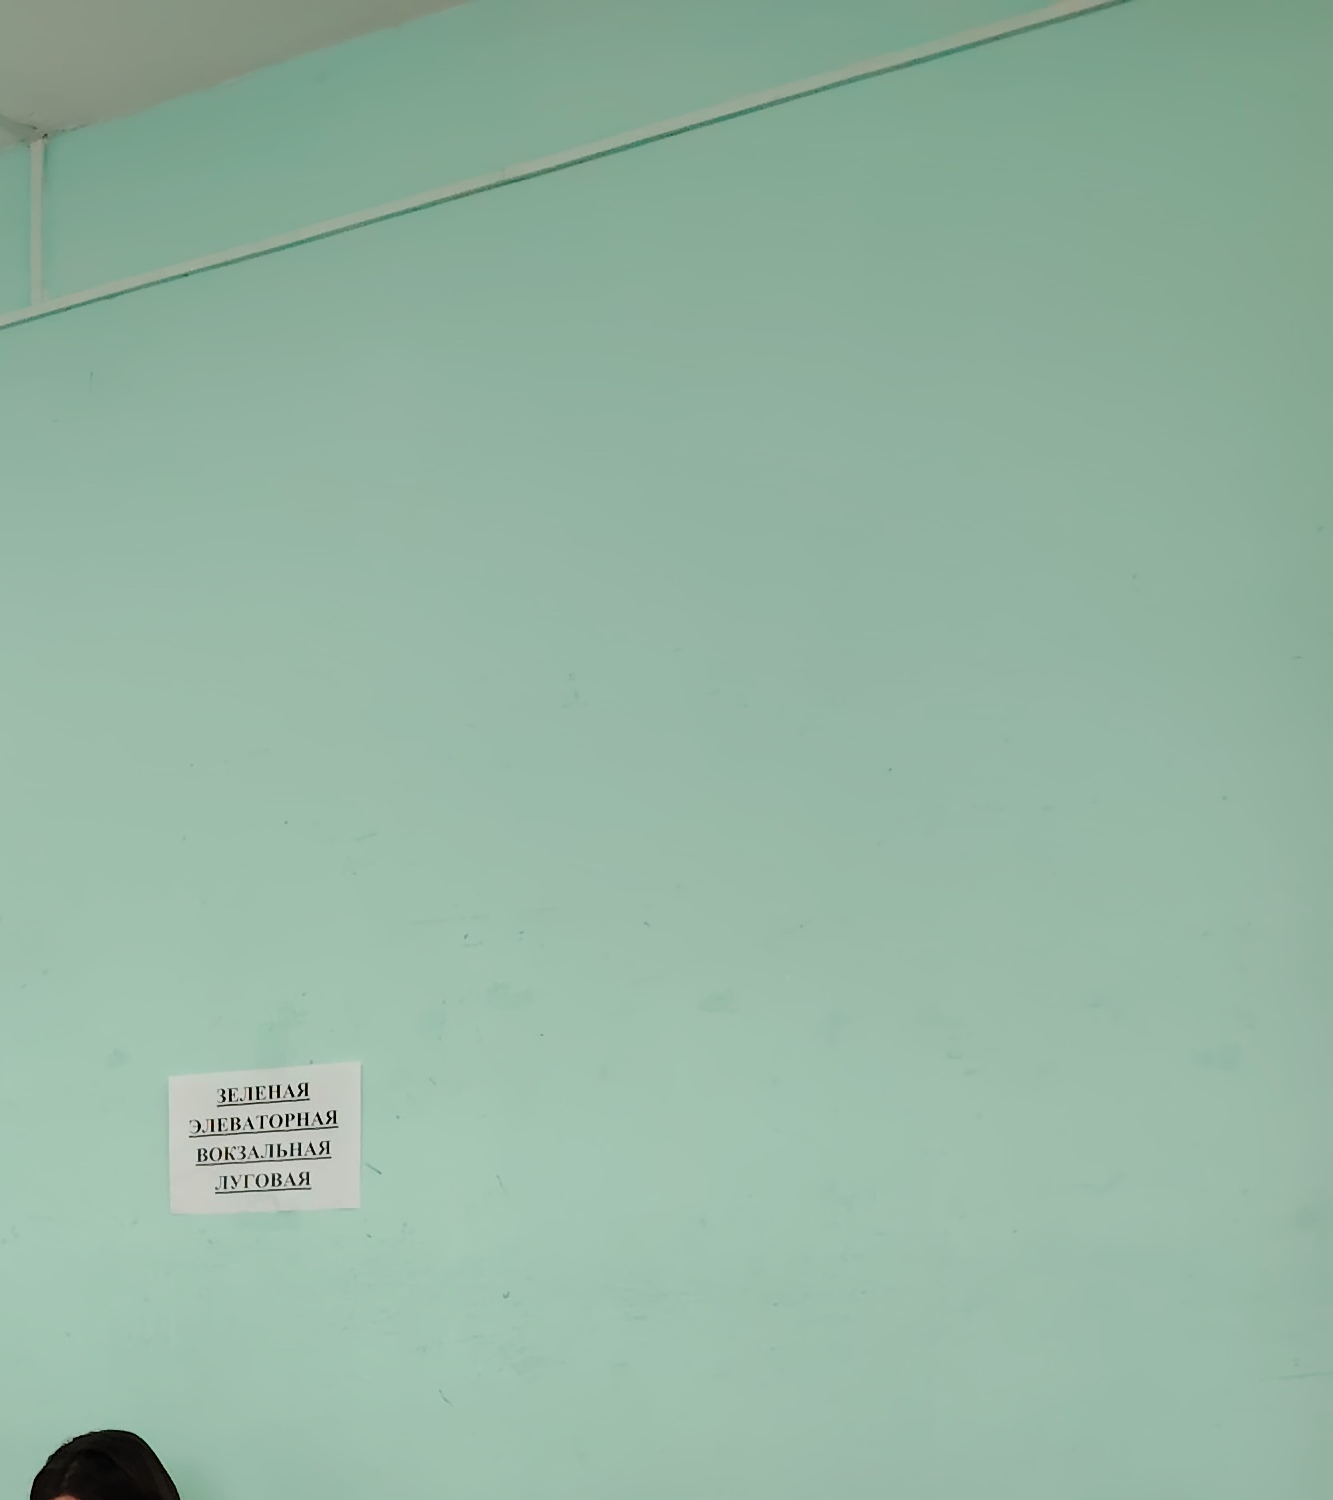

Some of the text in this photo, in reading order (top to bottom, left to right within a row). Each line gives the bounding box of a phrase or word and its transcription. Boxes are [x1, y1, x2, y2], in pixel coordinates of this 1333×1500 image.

[216, 1082, 311, 1104] ЗЕЛЕНАЯ
[189, 1109, 339, 1134] ЭЛЕВАТОРНАЯ
[196, 1140, 332, 1163] ВОКЗАЛЬНАЯ
[214, 1171, 312, 1191] ЛУГОВАЯ
